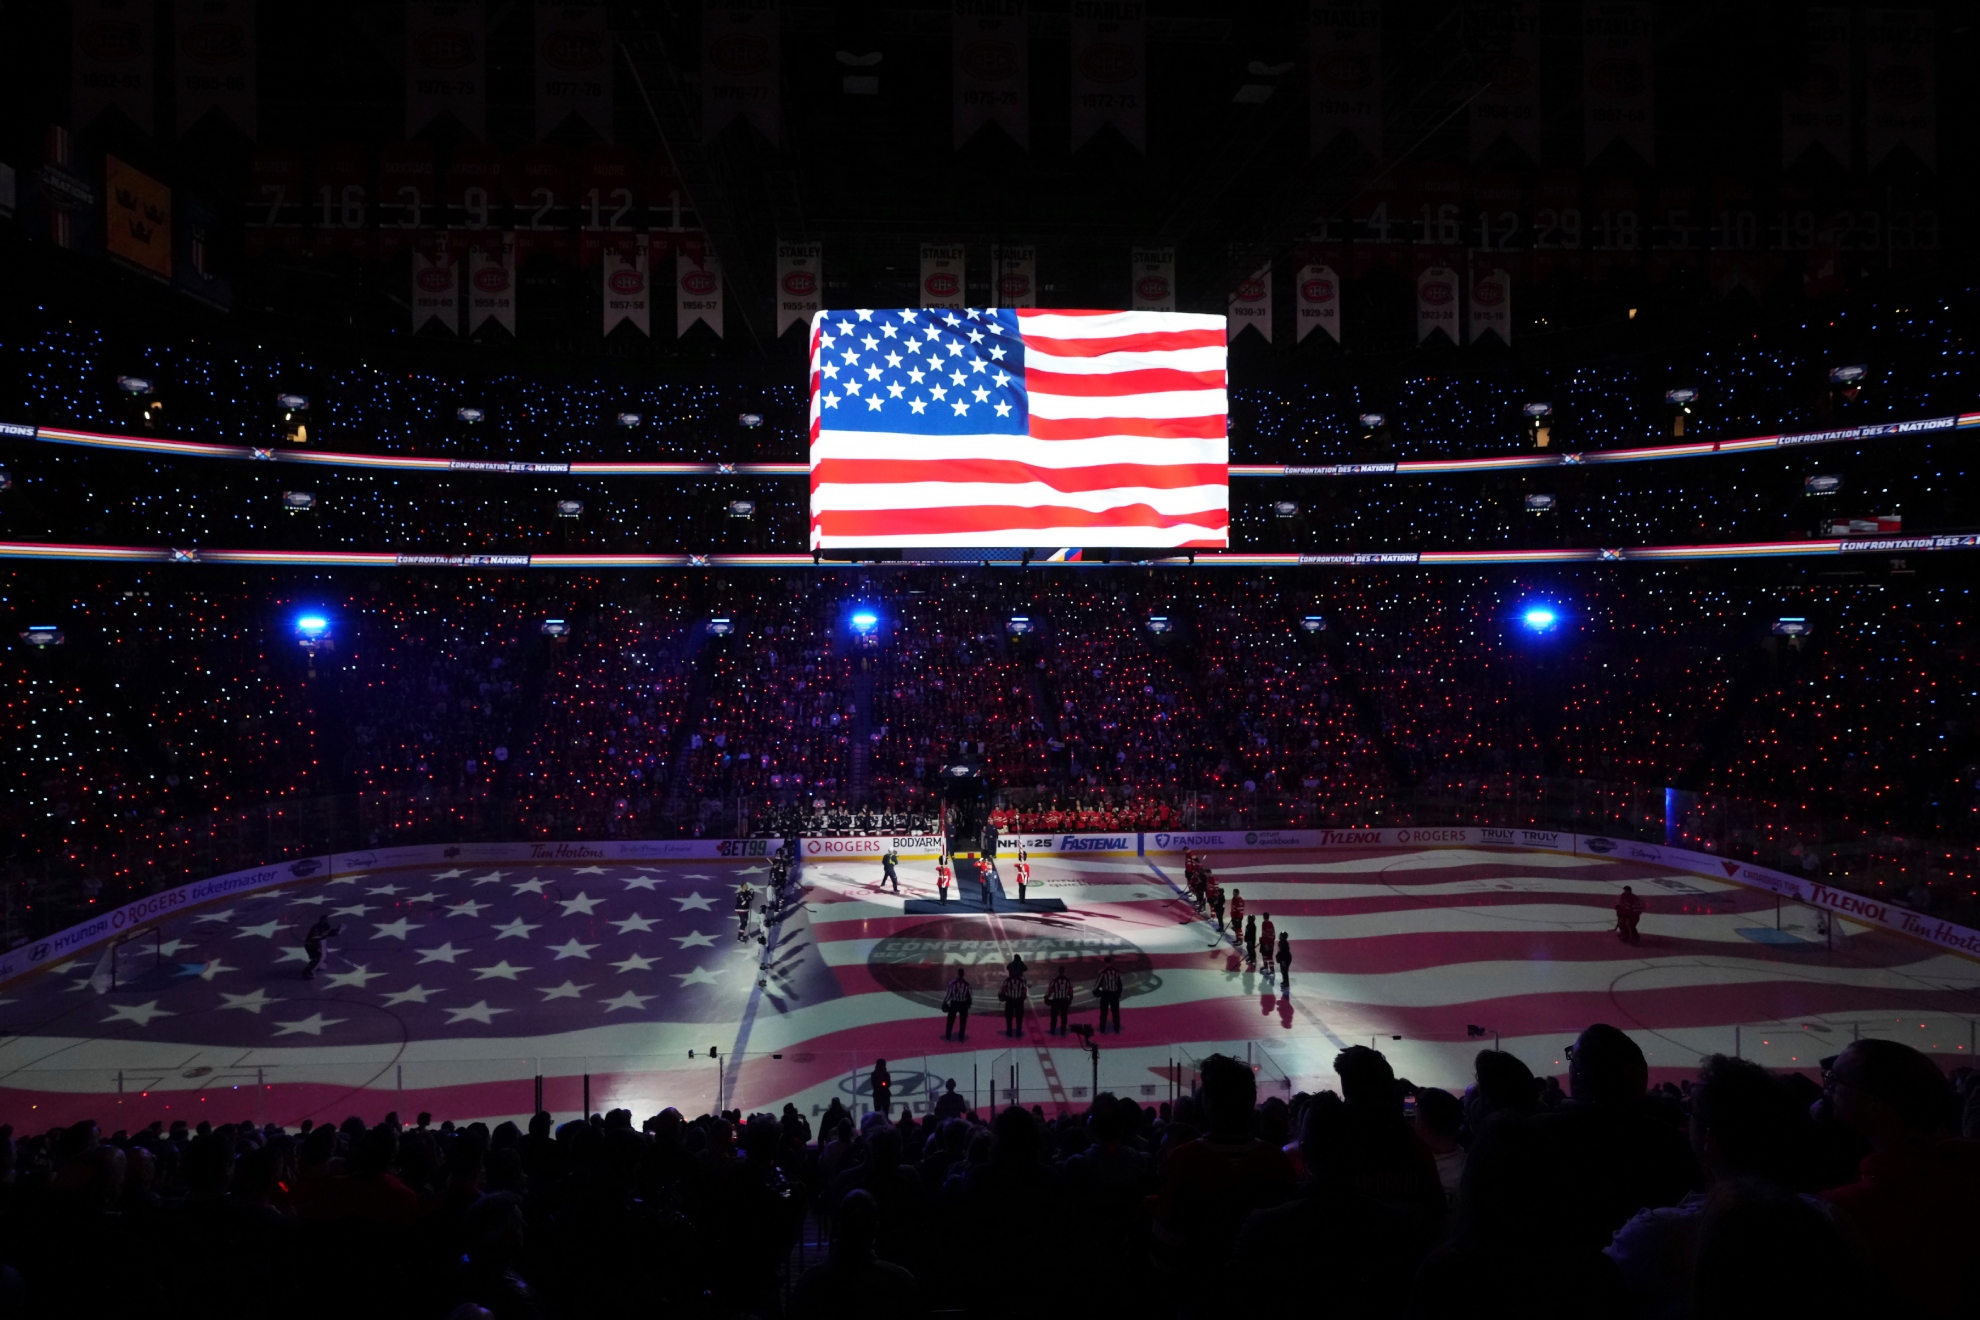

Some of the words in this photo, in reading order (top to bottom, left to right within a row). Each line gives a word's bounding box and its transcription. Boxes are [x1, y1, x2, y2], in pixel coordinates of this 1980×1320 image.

[1075, 2, 1142, 20] STANLEY
[1312, 9, 1378, 27] STANLEY
[417, 79, 475, 94] 1978-79
[545, 82, 601, 97] 1977-78
[713, 85, 769, 99] 1976-77
[963, 91, 1018, 105] 1975-76
[1081, 94, 1136, 108] 1972-73
[1319, 101, 1371, 115] 1970-71
[1478, 104, 1532, 119] 1968-69
[319, 184, 365, 229] 16
[397, 185, 421, 230] 3
[464, 186, 488, 231] 9
[531, 187, 554, 231] 2
[587, 187, 633, 232] 12
[1367, 202, 1391, 243] 4
[1420, 203, 1459, 244] 16
[1538, 207, 1582, 249] 29
[1600, 209, 1639, 250] 18
[1668, 209, 1690, 250] 5
[1719, 210, 1756, 250] 10
[1777, 210, 1816, 250] 19
[1478, 211, 1519, 252] 12
[779, 246, 820, 257] STANLEY
[922, 248, 963, 259] STANLEY
[1133, 252, 1173, 263] STANLEY
[609, 301, 645, 310] 1957-58
[682, 301, 718, 310] 1956-57
[783, 302, 818, 311] 1955-56
[1234, 308, 1266, 316] 1930-31
[1301, 308, 1334, 317] 1929-30
[1421, 311, 1454, 320] 1923-24
[0, 424, 35, 436] TIONS
[1779, 429, 1861, 445] CONFRONTATION
[1862, 427, 1884, 437] DES
[1898, 418, 1954, 433] NATIONS
[451, 461, 510, 470] CONFRONTATION
[1285, 466, 1337, 474] CONFRONTATION
[1338, 465, 1351, 473] DES
[1361, 463, 1394, 472] NATIONS
[1842, 539, 1934, 551] CONFRONTATION
[1936, 537, 1960, 547] DES
[464, 556, 480, 564] DES
[490, 556, 528, 565] NATIONS
[1300, 555, 1355, 563] CONFRONTATION
[1381, 554, 1418, 562] NATIONS
[1173, 836, 1224, 846] FANDUEL
[1258, 837, 1300, 846] quickbooks
[1320, 830, 1382, 846] TYLENOL
[1414, 830, 1466, 842] ROGERS
[1481, 829, 1515, 839] TRULY
[1522, 831, 1559, 843] TRULY
[825, 841, 881, 852] ROGERS
[892, 837, 942, 848] BODYARM
[1034, 839, 1053, 848] 25
[1060, 836, 1128, 850] FASTENAL
[530, 843, 554, 858] Tim
[555, 843, 604, 859] Hortons
[191, 870, 278, 900] ticketmaster
[1742, 869, 1783, 890] CANADIAN
[128, 889, 187, 922] ROGERS
[1810, 882, 1889, 924] TYLENOL
[54, 920, 108, 951] HYUNDAI
[1901, 911, 1932, 939] Tim
[1933, 921, 1980, 953] Horto
[886, 936, 1123, 951] CONFRONTATION
[942, 947, 1142, 966] NATIONS
